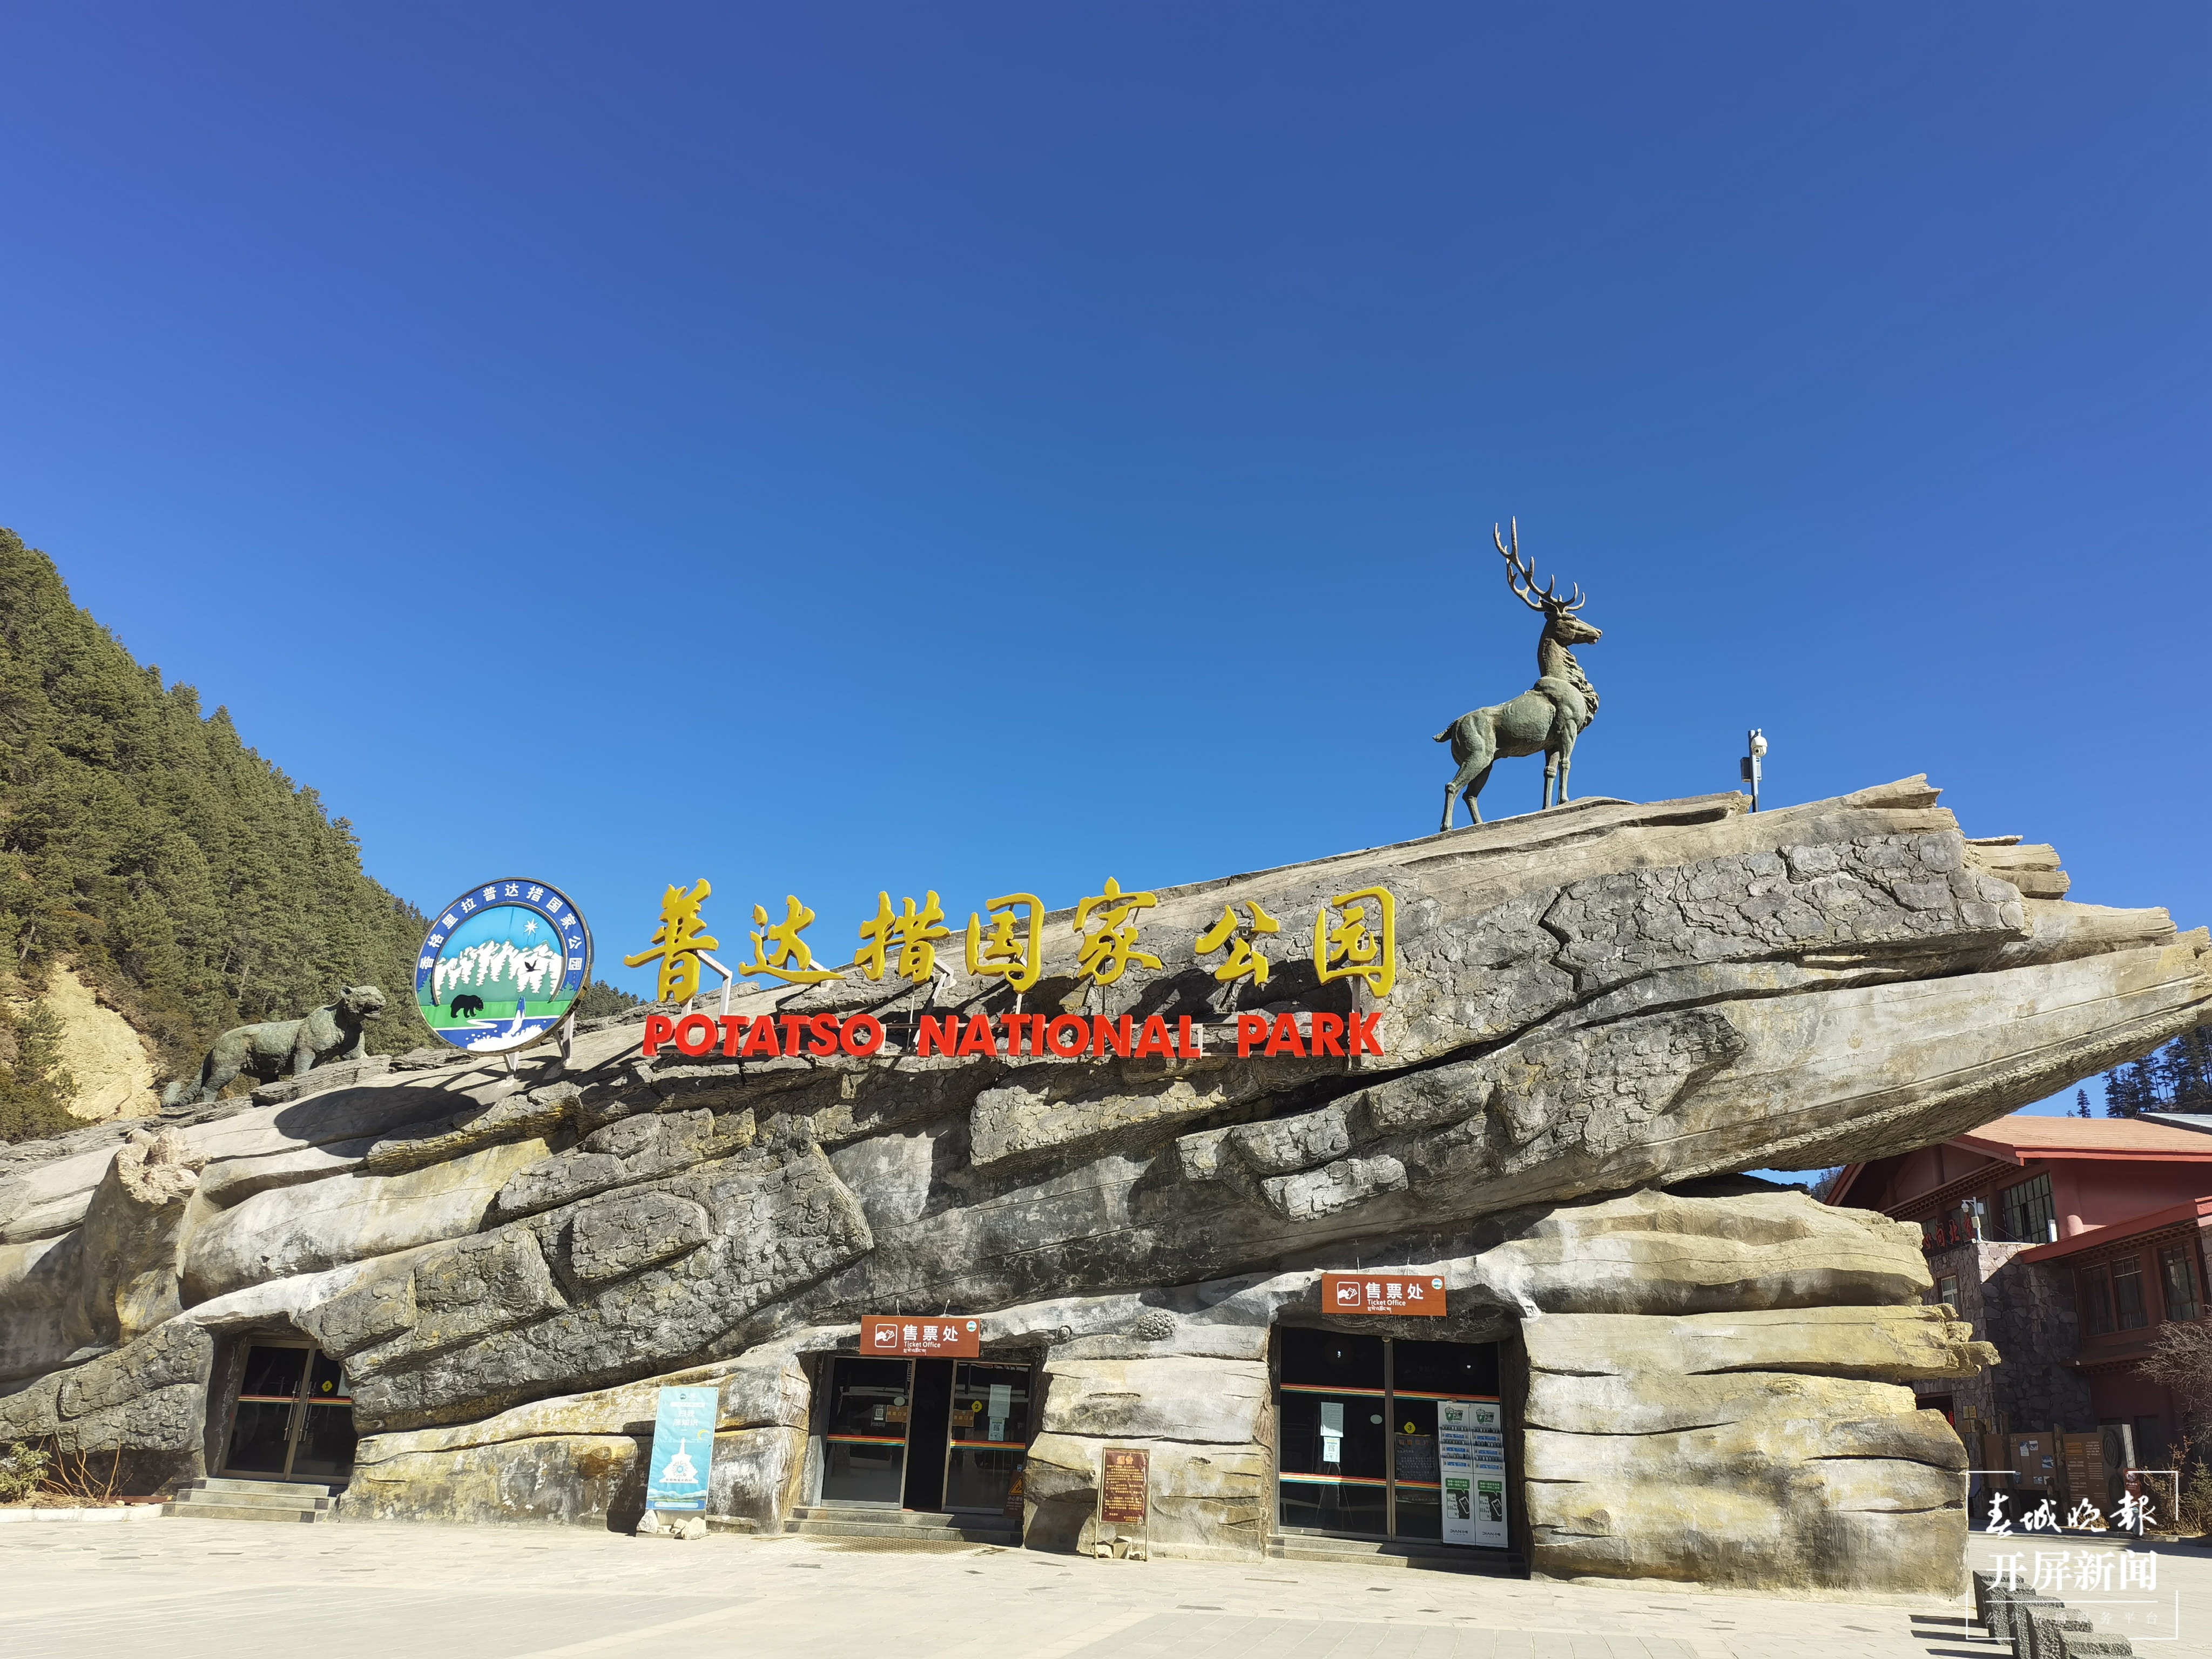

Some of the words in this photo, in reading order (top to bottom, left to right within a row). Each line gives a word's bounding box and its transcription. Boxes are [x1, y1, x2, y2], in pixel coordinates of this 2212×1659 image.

[420, 883, 583, 971] 香格里拉普达措国家公园
[623, 876, 1395, 1004] 普达措国家公园
[642, 1013, 886, 1057] POTATSO
[918, 1013, 1202, 1058] NATIONAL
[1237, 1012, 1385, 1057] PARK
[1365, 1282, 1424, 1300] 售票处
[903, 1324, 958, 1342] 售票处
